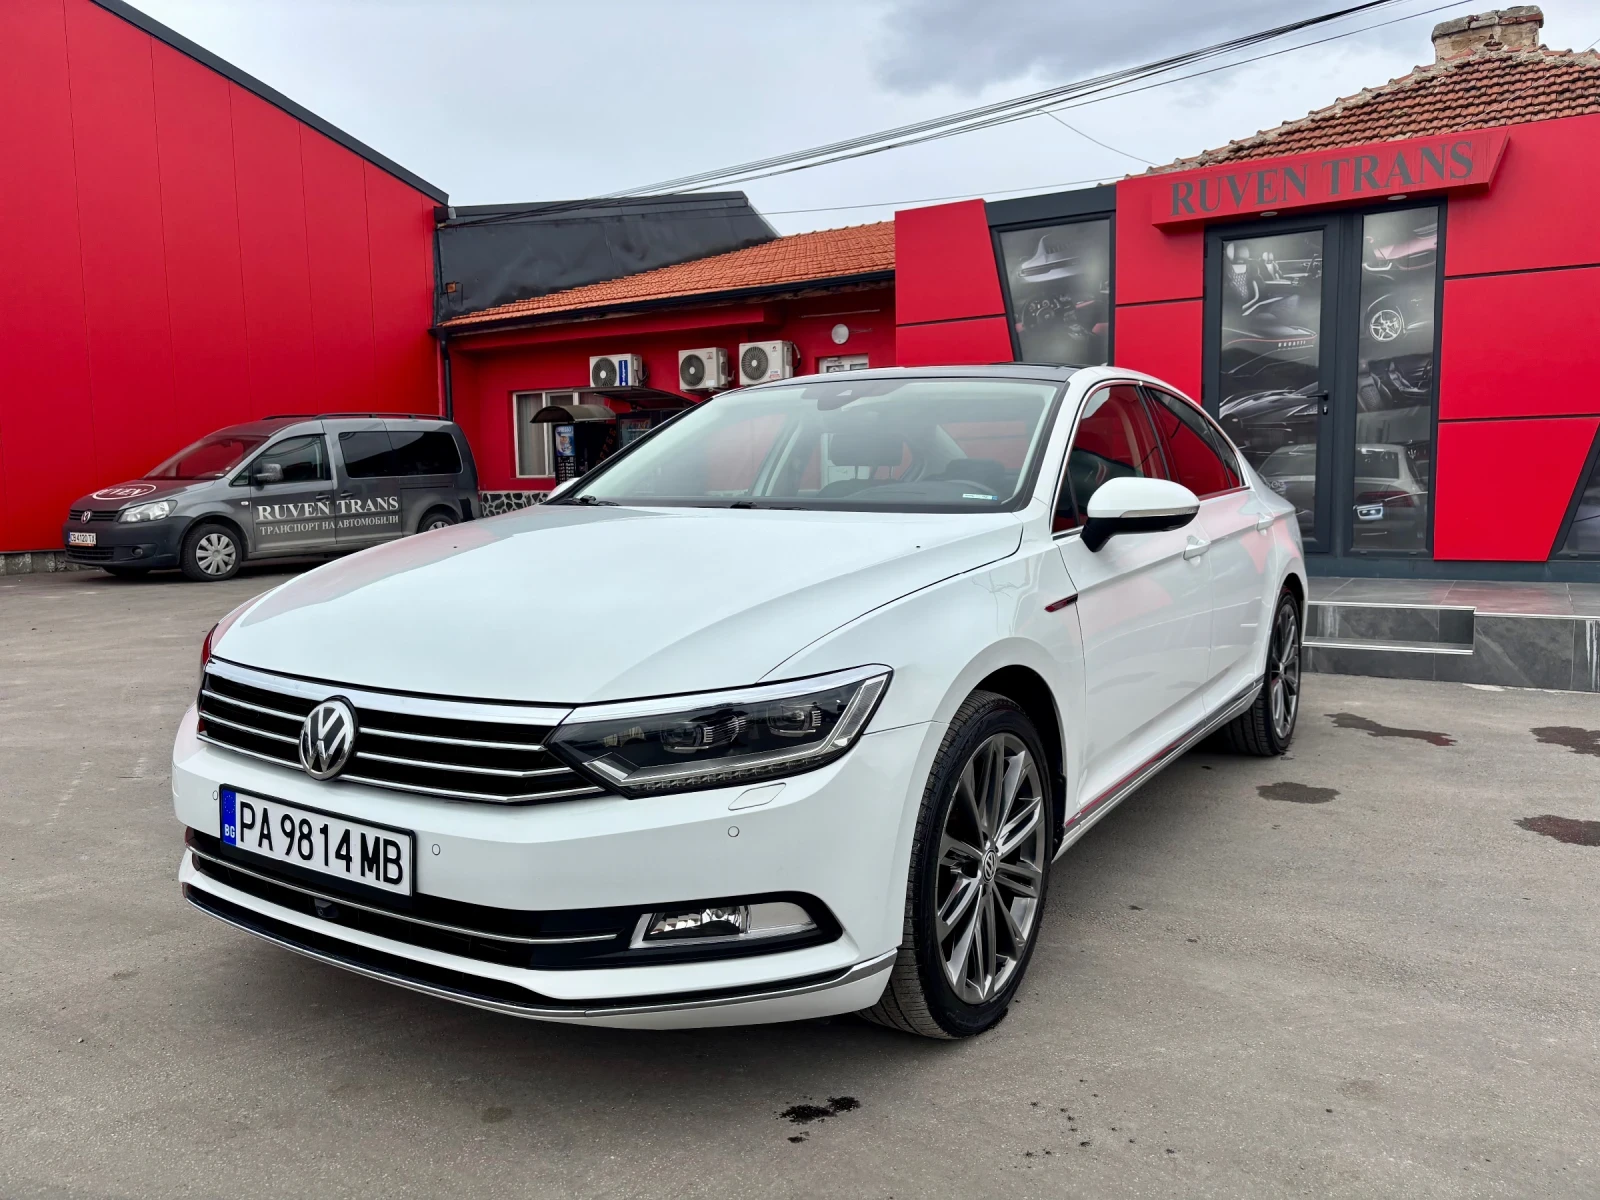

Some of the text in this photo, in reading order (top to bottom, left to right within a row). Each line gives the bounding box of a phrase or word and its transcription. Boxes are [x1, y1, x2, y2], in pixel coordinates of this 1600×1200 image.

[1170, 141, 1473, 217] RUVEN TRANS
[256, 496, 399, 522] RUVEN TRANS
[260, 515, 399, 535] ТРАНСПОРТ НА АВТОМОБИЛИ
[224, 823, 236, 838] BG
